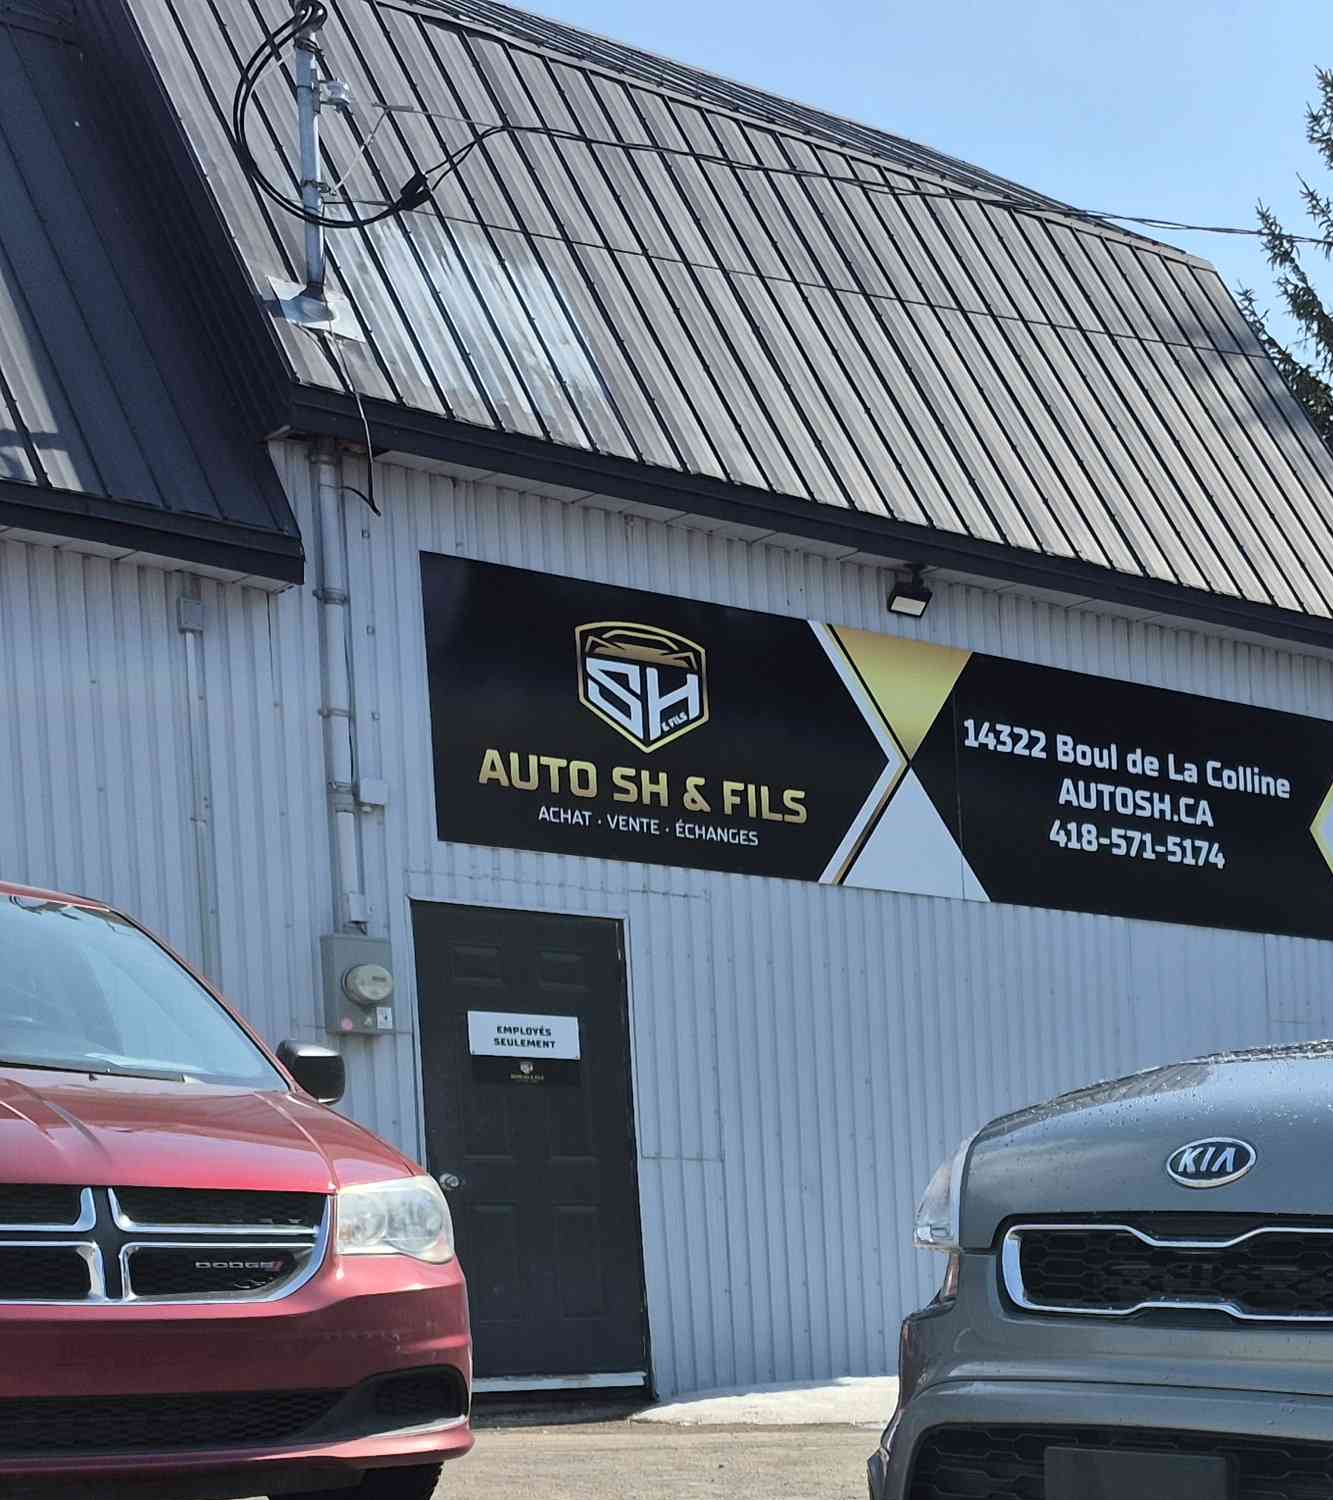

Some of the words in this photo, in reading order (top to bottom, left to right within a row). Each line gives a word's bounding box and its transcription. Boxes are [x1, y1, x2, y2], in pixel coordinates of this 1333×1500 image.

[964, 718, 1047, 759] 14322
[1056, 734, 1118, 770] Boul
[1127, 748, 1160, 777] de
[1168, 753, 1198, 784] La
[1206, 760, 1291, 799] Colline
[478, 749, 598, 798] AUTO
[612, 766, 669, 807] SH
[683, 776, 712, 813] &
[723, 780, 808, 824] FILS
[1058, 778, 1214, 827] AUTOSH.CA
[538, 805, 593, 827] ACHAT
[606, 813, 660, 835] VENTE
[675, 819, 759, 846] ÉCHANGES
[1049, 819, 1226, 869] 418-571-5174
[494, 1038, 556, 1048] SEULEMENT
[1178, 1147, 1236, 1173] KIA
[195, 1261, 274, 1270] DODGE
